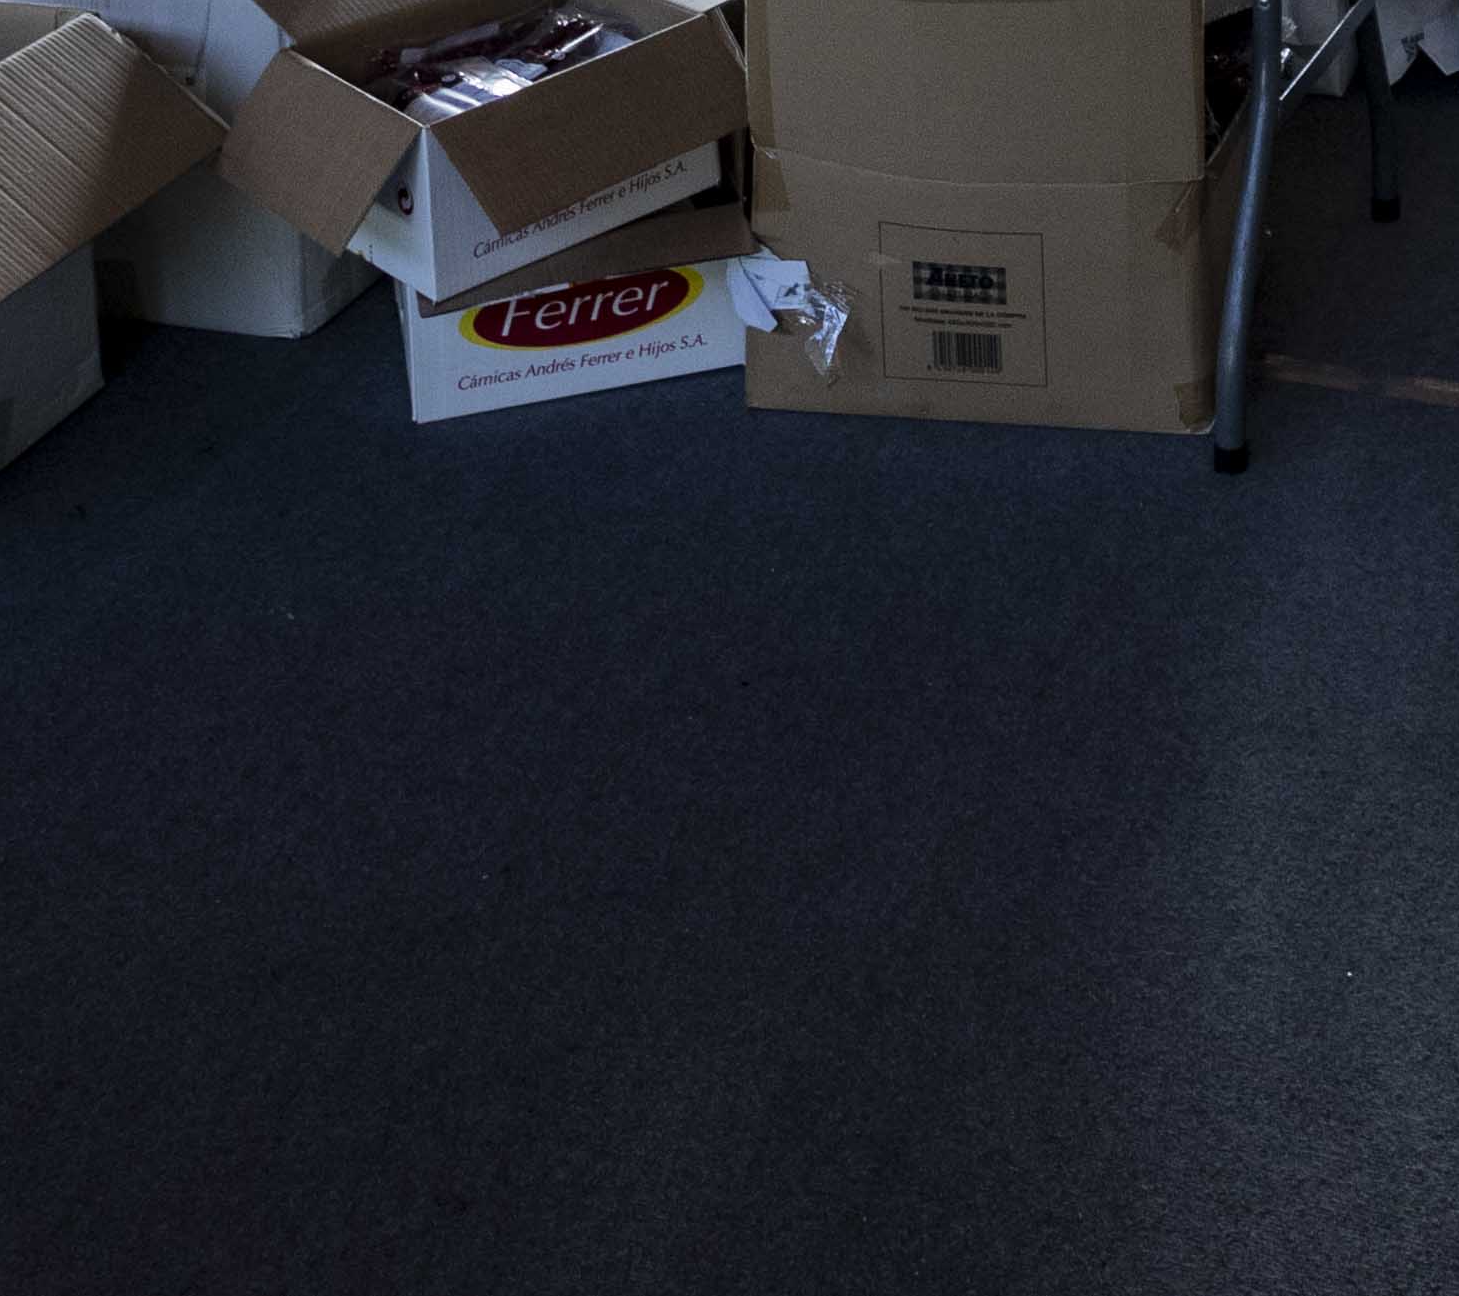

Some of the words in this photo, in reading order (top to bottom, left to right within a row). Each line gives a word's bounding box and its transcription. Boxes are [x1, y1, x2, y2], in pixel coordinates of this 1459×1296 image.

[472, 227, 529, 260] Cárnicas
[629, 169, 662, 196] Hijos
[664, 160, 688, 182] S.A.
[501, 279, 670, 338] Ferrer
[457, 367, 522, 391] Cárnicas
[524, 353, 576, 378] Andrés
[579, 349, 623, 369] Ferrer
[625, 348, 636, 358] e
[638, 338, 677, 361] Hijos
[680, 333, 708, 350] S.A.
